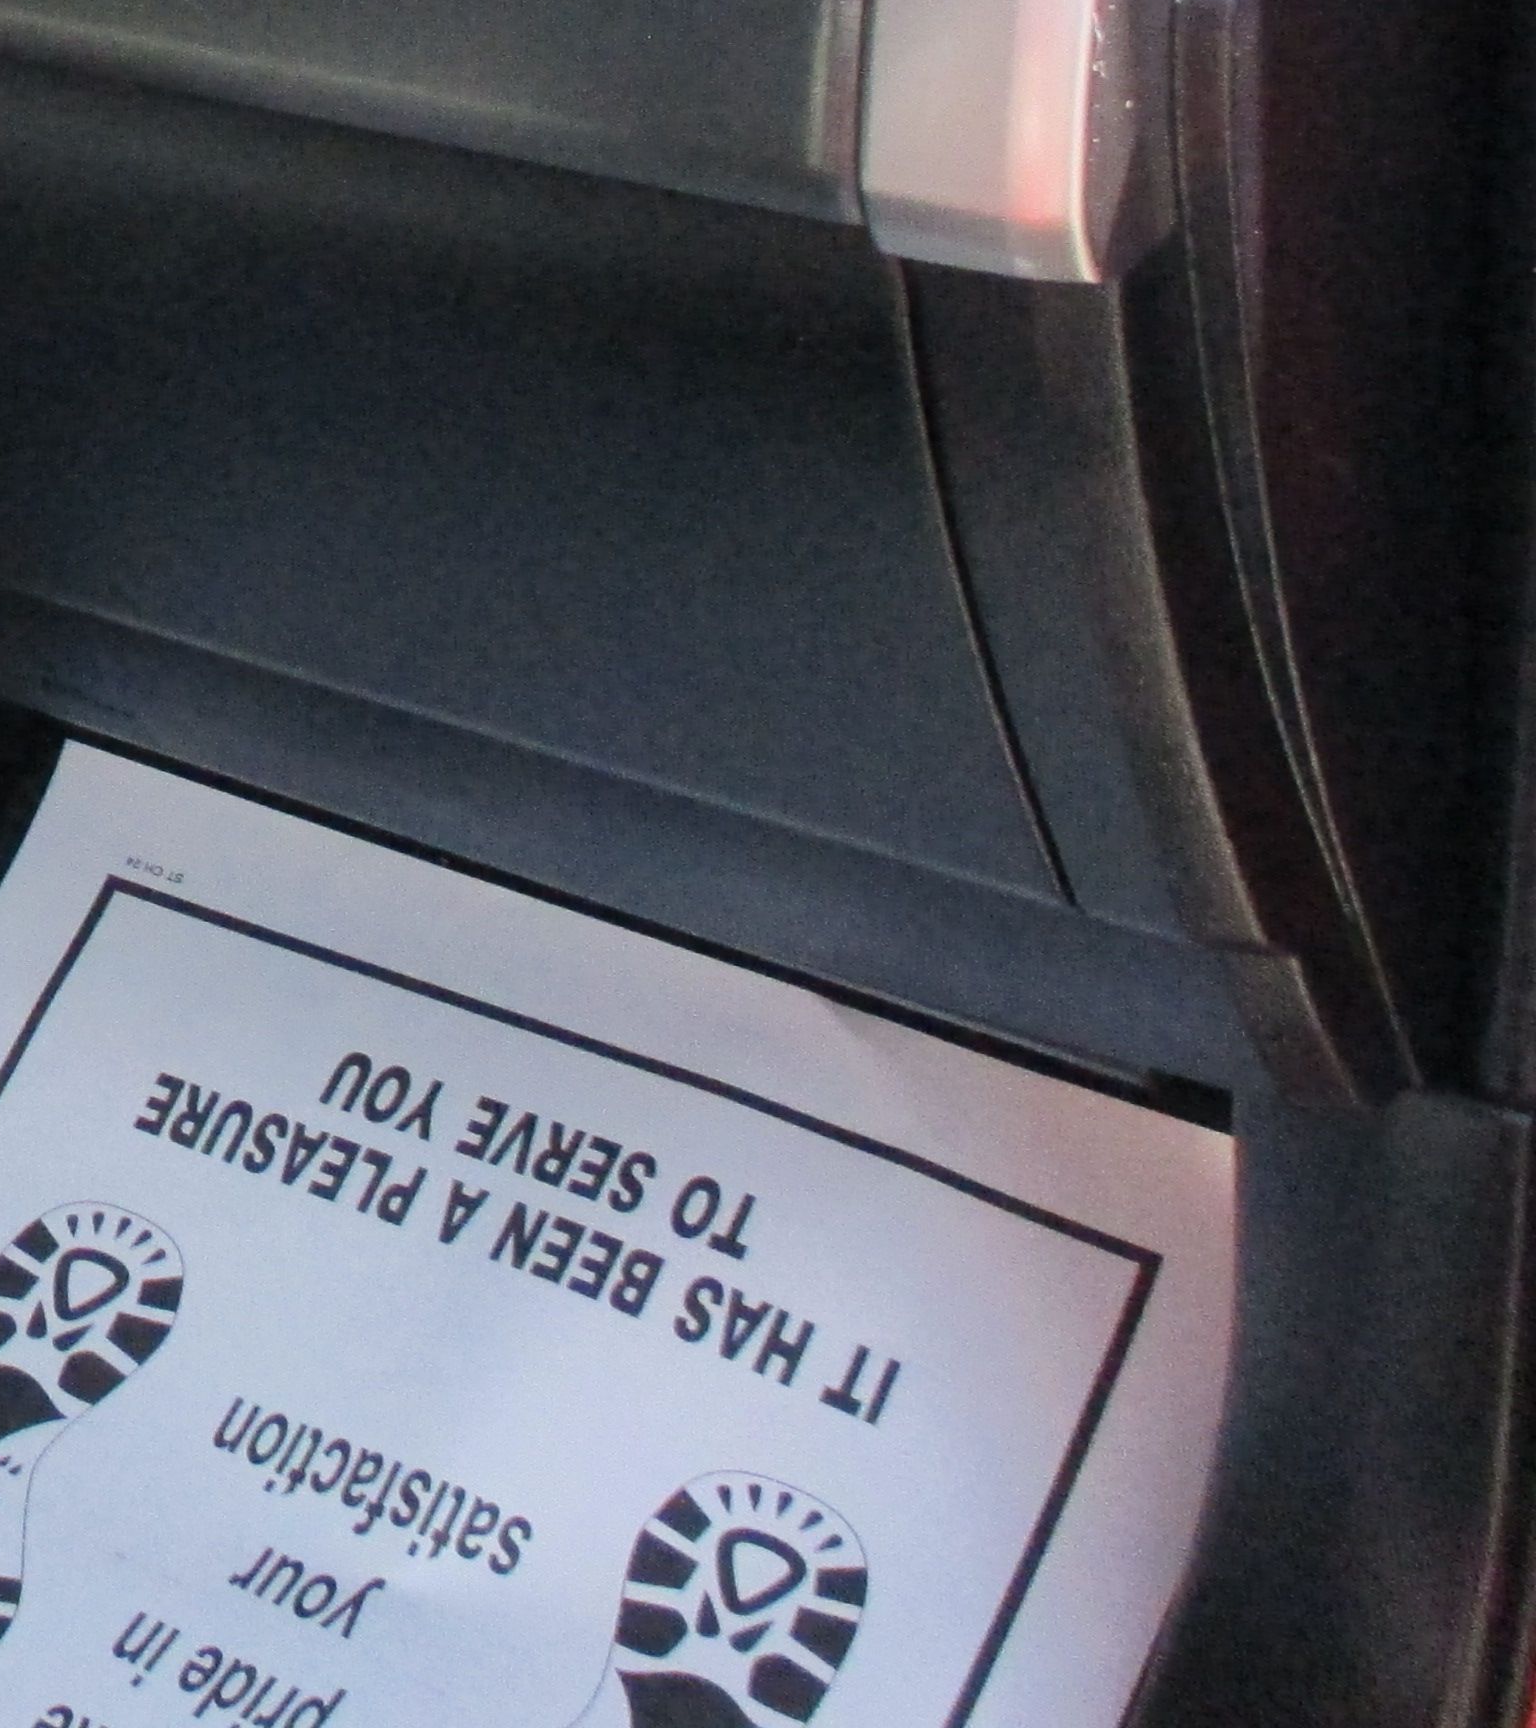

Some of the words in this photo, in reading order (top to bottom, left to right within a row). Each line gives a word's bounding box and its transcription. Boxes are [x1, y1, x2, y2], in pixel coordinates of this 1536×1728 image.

[318, 1051, 446, 1142] YOU
[131, 1072, 429, 1228] PLEASURE
[454, 1094, 660, 1215] SERVE
[436, 1179, 491, 1246] A
[670, 1174, 758, 1260] TO
[489, 1200, 667, 1319] BEEN
[672, 1274, 816, 1388] HAS
[819, 1343, 902, 1426] IT
[211, 1395, 534, 1577] satisfaction
[227, 1546, 387, 1640] your
[110, 1610, 181, 1689] in
[177, 1643, 348, 1728] pride
